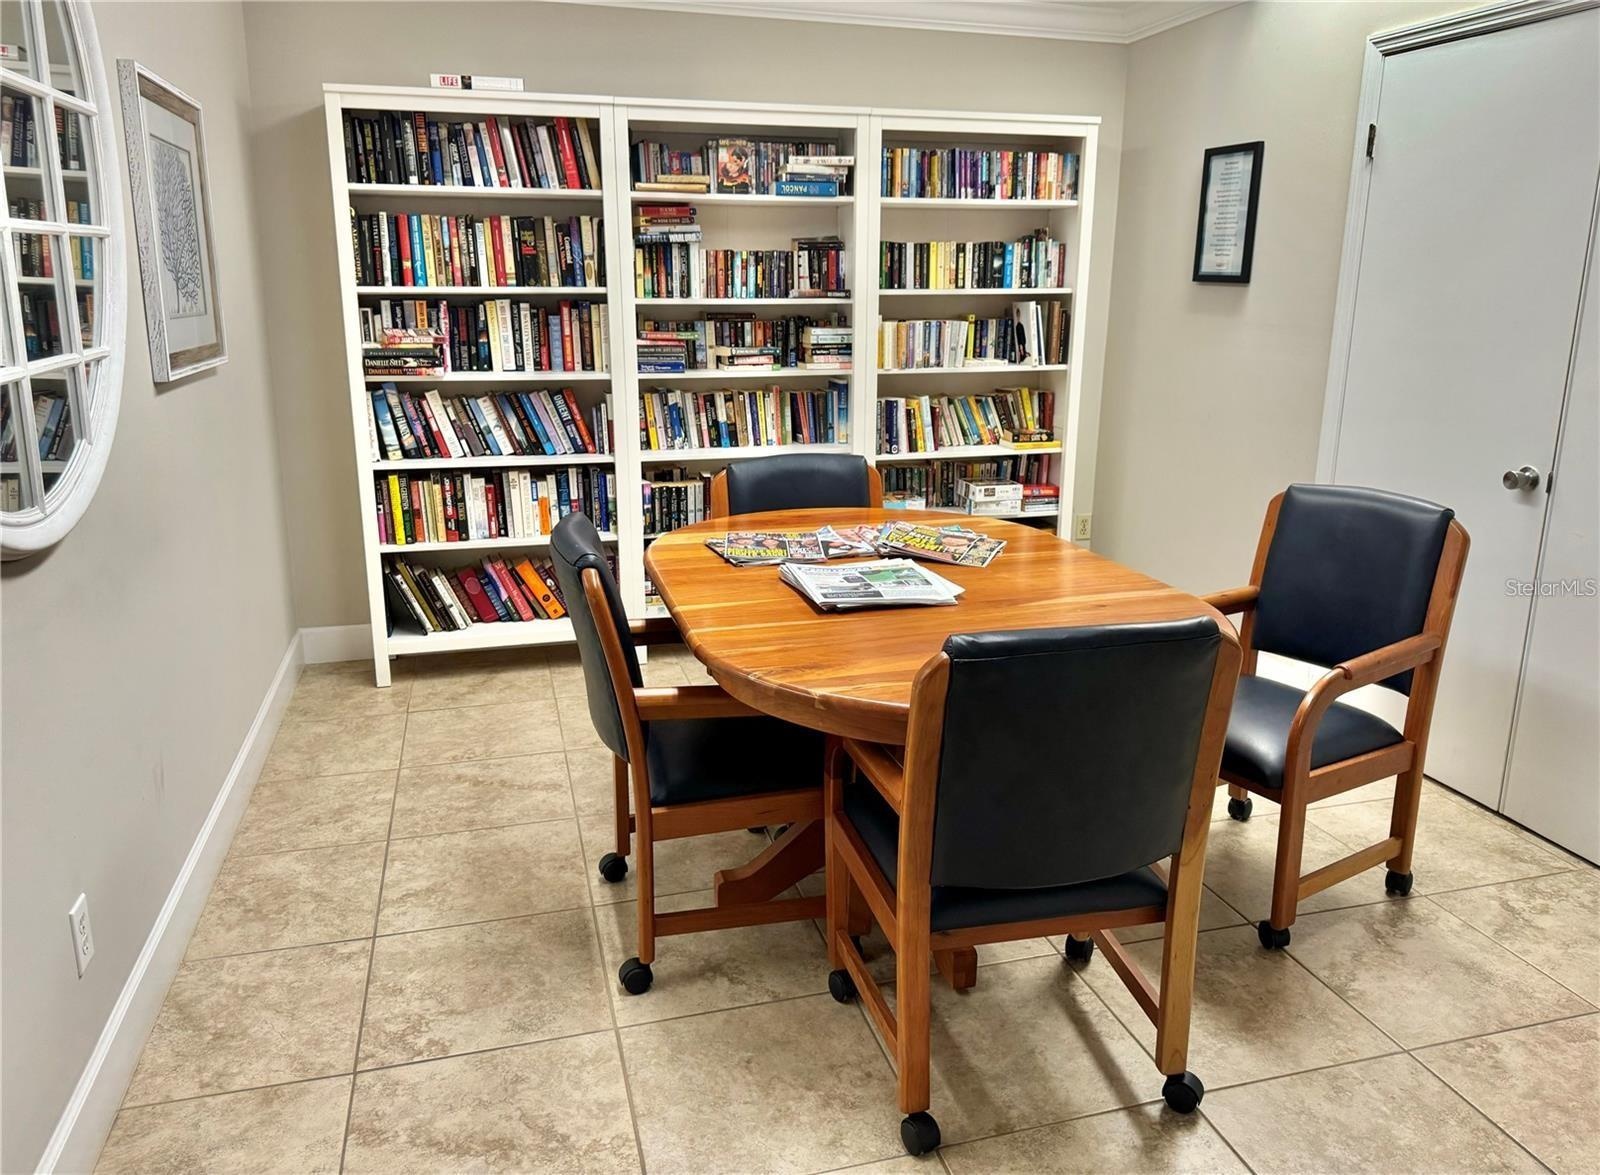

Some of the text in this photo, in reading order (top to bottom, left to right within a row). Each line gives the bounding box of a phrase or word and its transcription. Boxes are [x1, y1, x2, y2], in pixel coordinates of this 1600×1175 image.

[440, 76, 458, 86] LIFE
[781, 184, 808, 192] PANCOL
[554, 394, 571, 421] ORIENT
